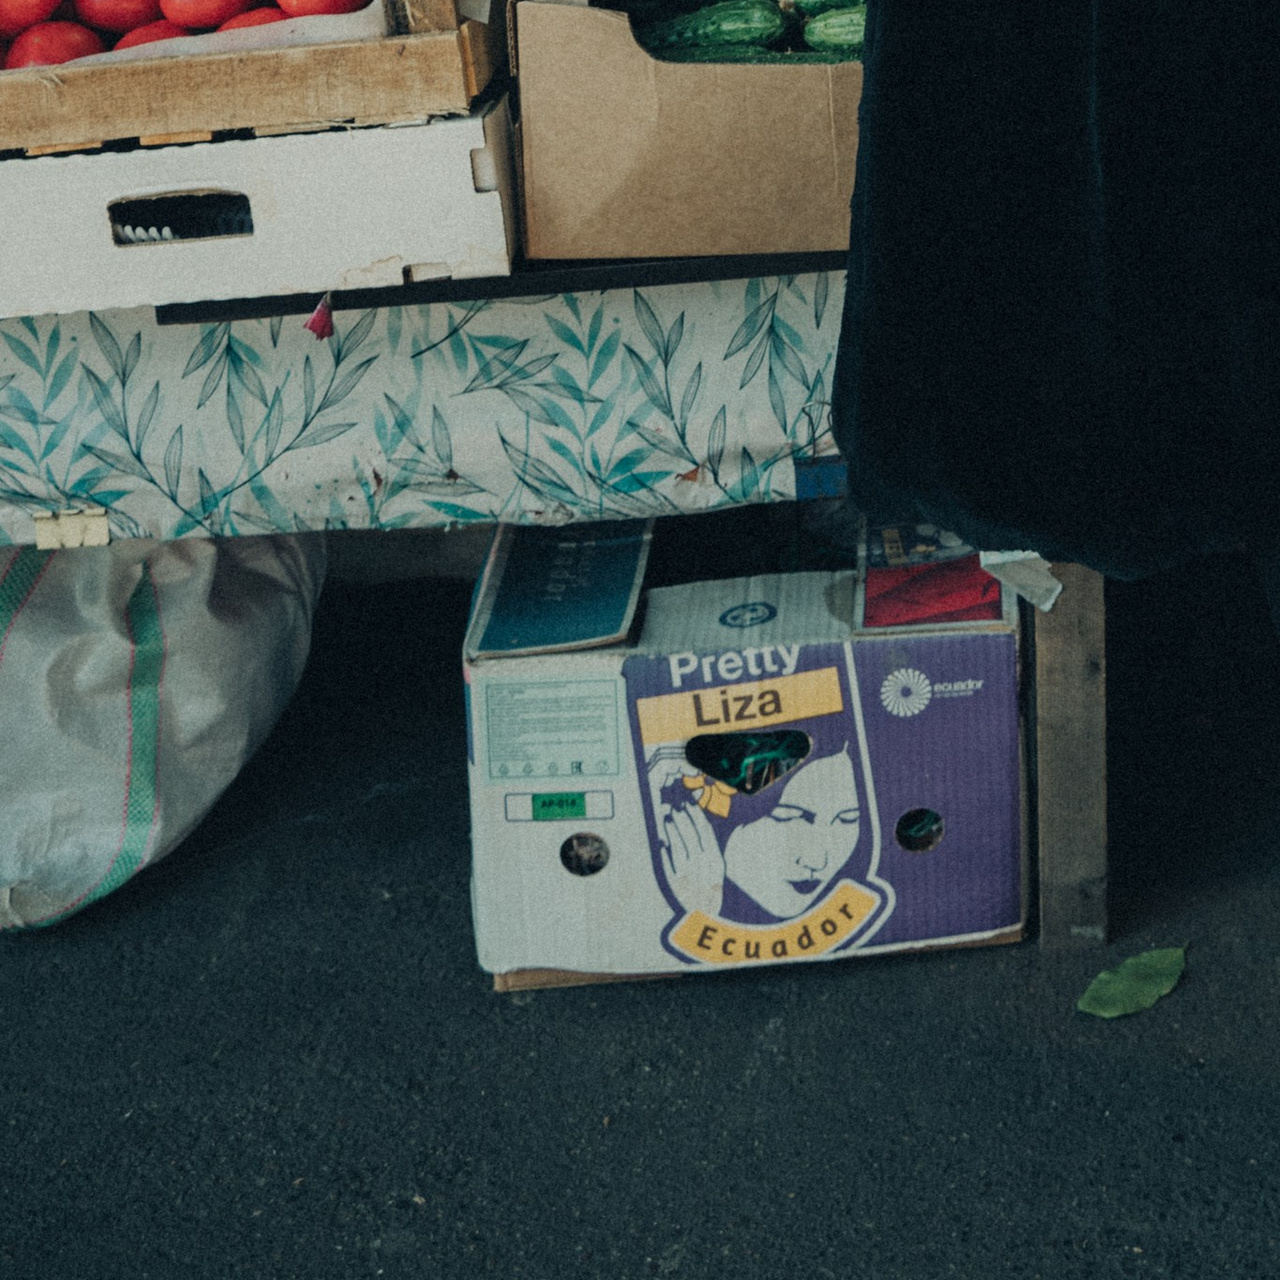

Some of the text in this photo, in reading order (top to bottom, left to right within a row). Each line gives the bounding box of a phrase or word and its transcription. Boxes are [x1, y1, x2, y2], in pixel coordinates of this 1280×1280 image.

[669, 643, 799, 688] Pretty
[933, 679, 984, 693] ecuador
[693, 689, 782, 727] Liza
[697, 903, 853, 958] Ecuador
